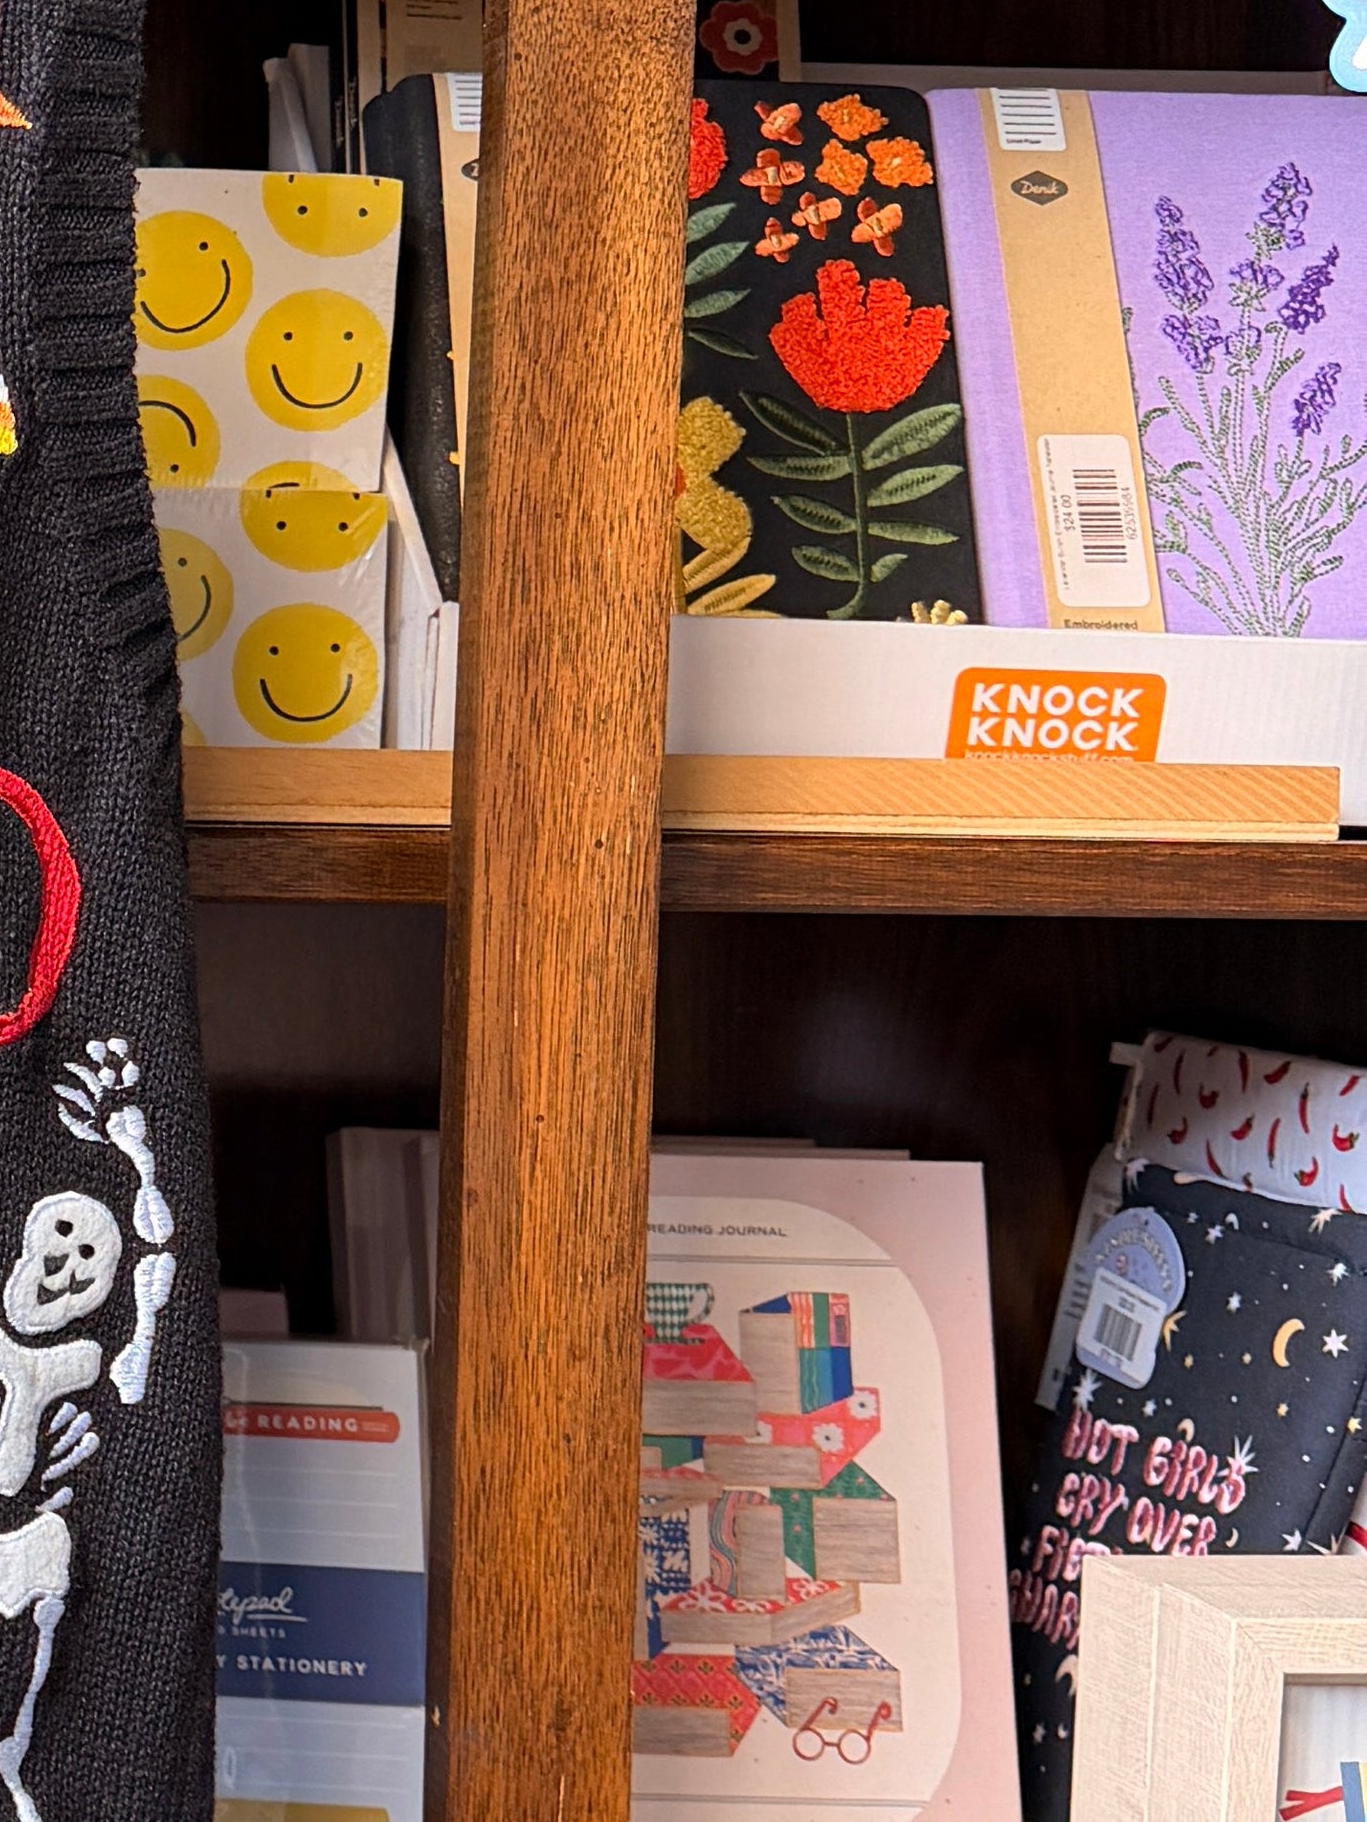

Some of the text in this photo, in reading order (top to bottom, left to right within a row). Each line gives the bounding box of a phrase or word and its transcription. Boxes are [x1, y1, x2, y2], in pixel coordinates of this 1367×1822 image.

[1021, 181, 1060, 195] Denik
[1064, 619, 1139, 630] Embroidered
[972, 683, 1143, 718] KNOCK
[967, 717, 1138, 751] KNOCK
[718, 1225, 787, 1237] JOURNAL
[257, 1414, 359, 1433] READING
[1063, 1410, 1247, 1514] HOT GIRLS
[1056, 1473, 1217, 1555] CRY OVER
[237, 1655, 367, 1677] STATIONERY
